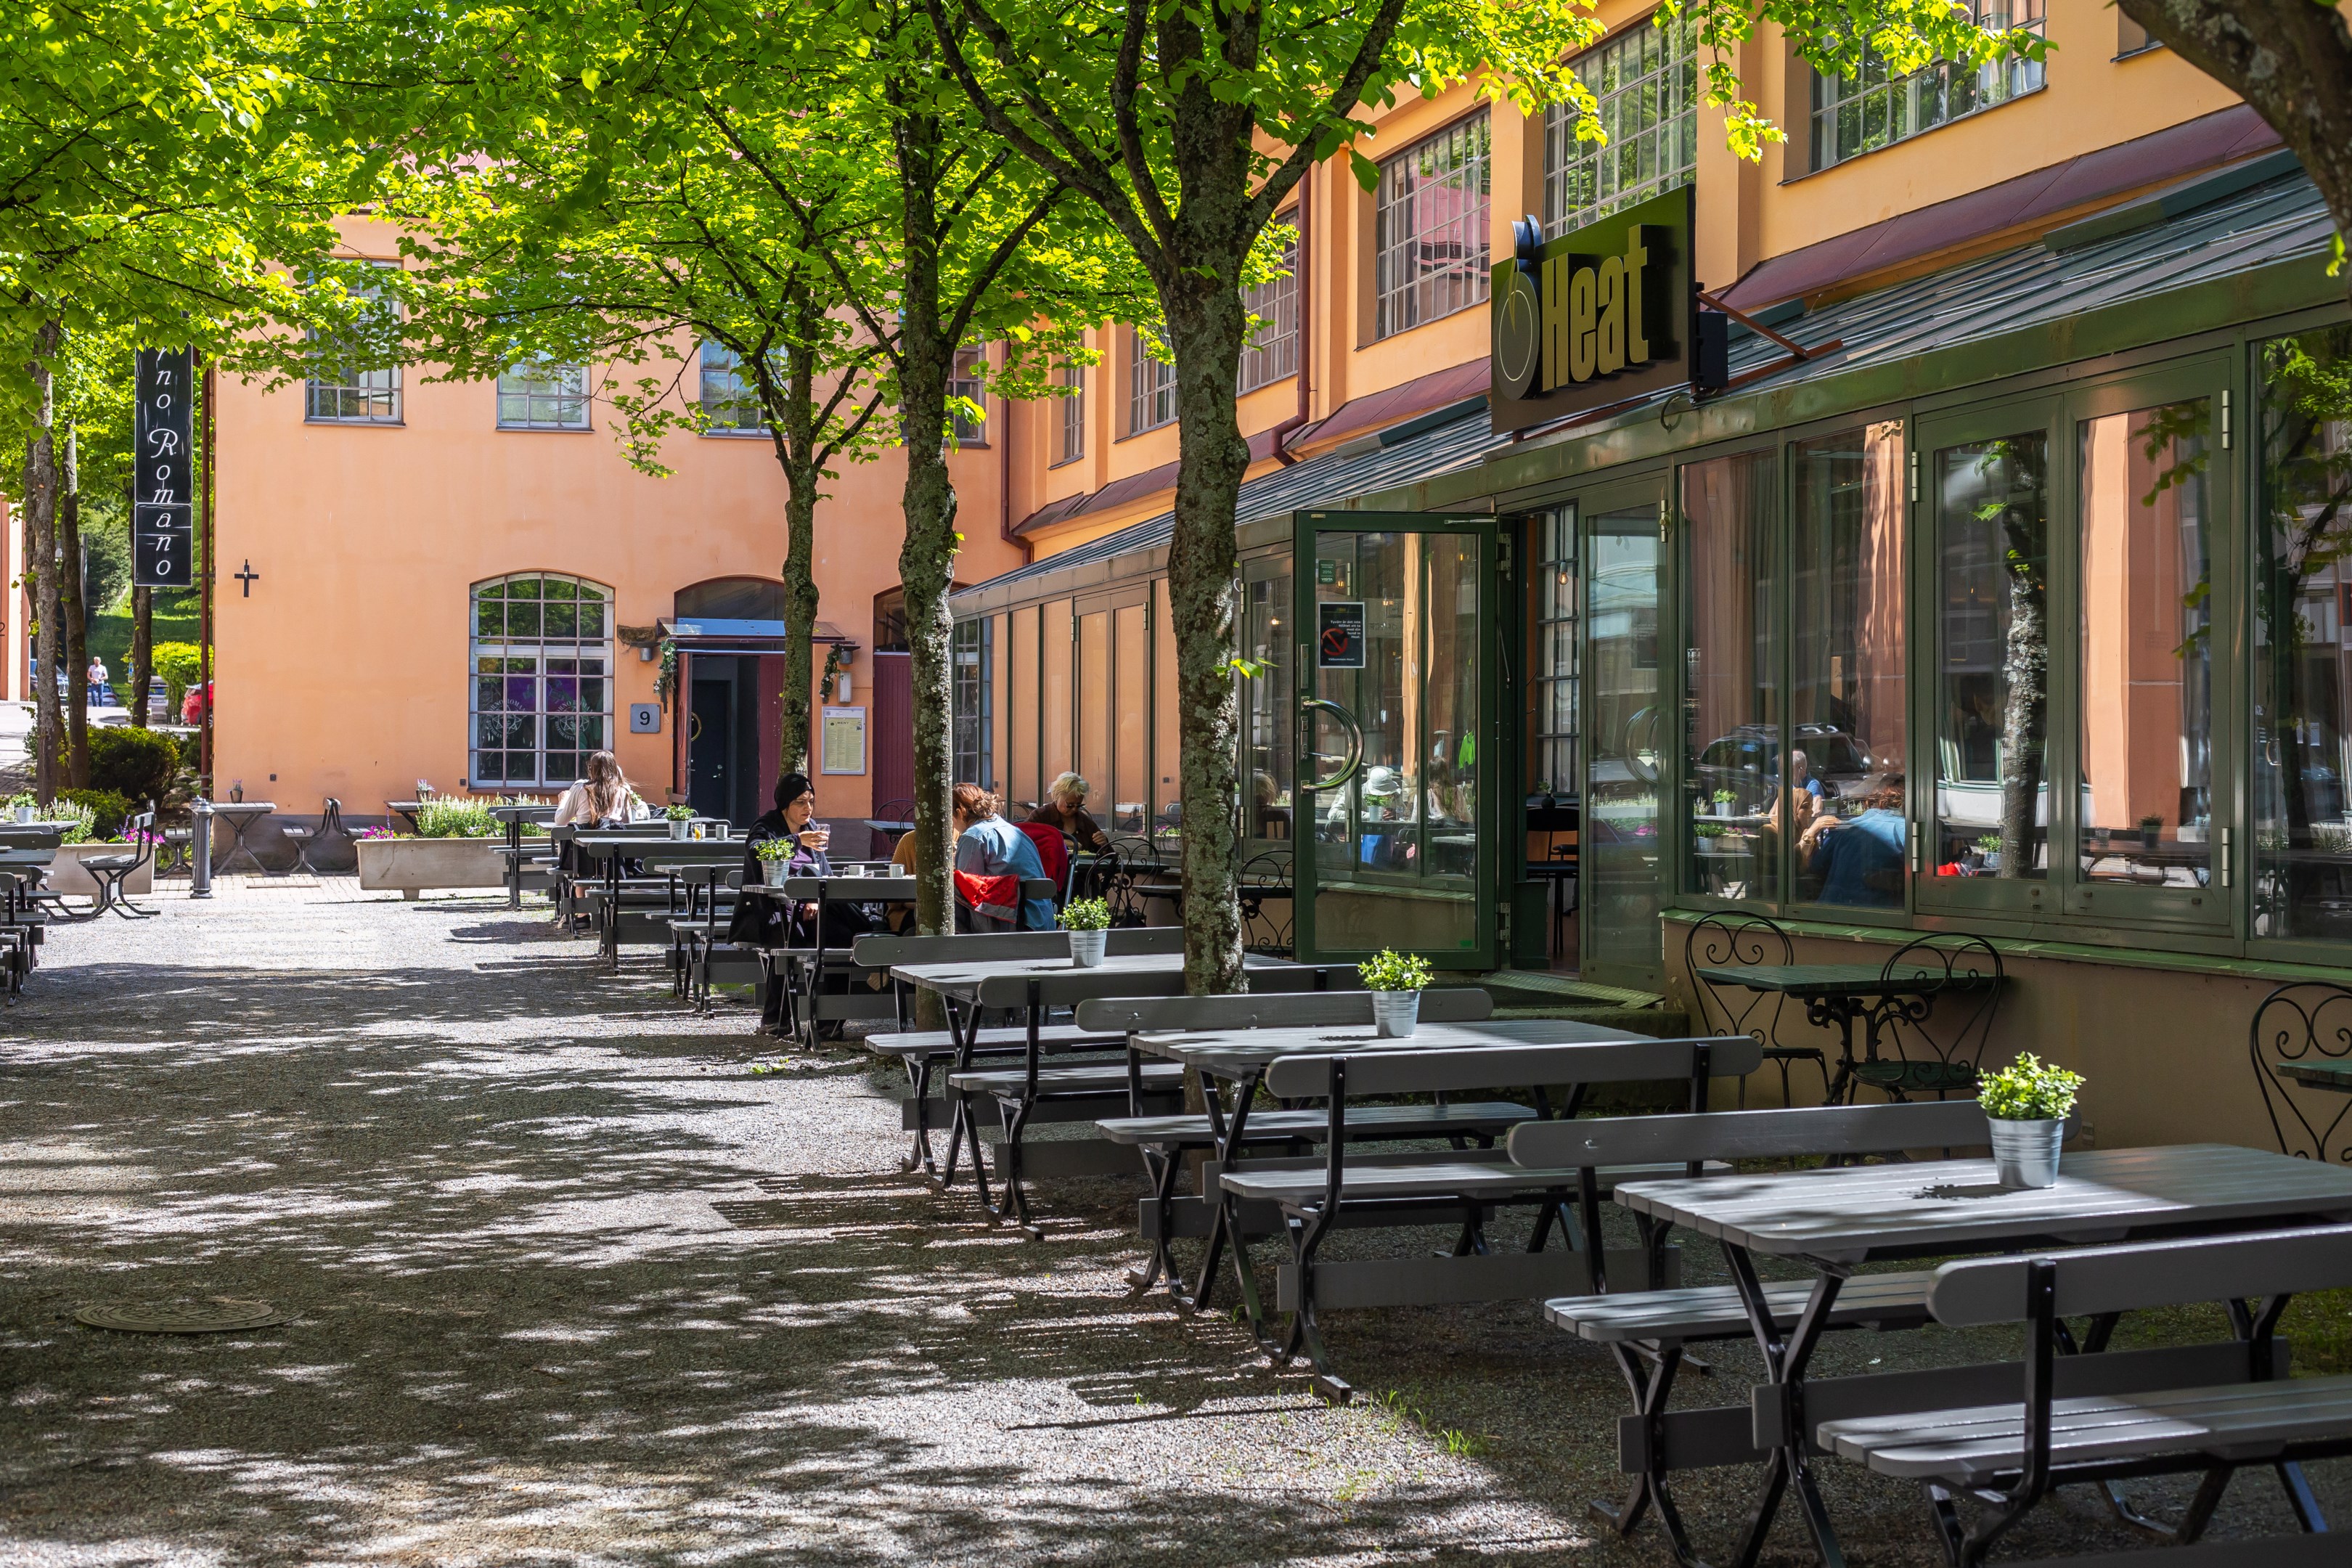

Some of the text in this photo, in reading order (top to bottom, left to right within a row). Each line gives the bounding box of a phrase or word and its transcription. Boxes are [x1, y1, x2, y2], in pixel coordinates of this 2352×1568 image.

[1542, 223, 1649, 392] Heat
[149, 428, 179, 576] Romano
[639, 711, 651, 726] 9
